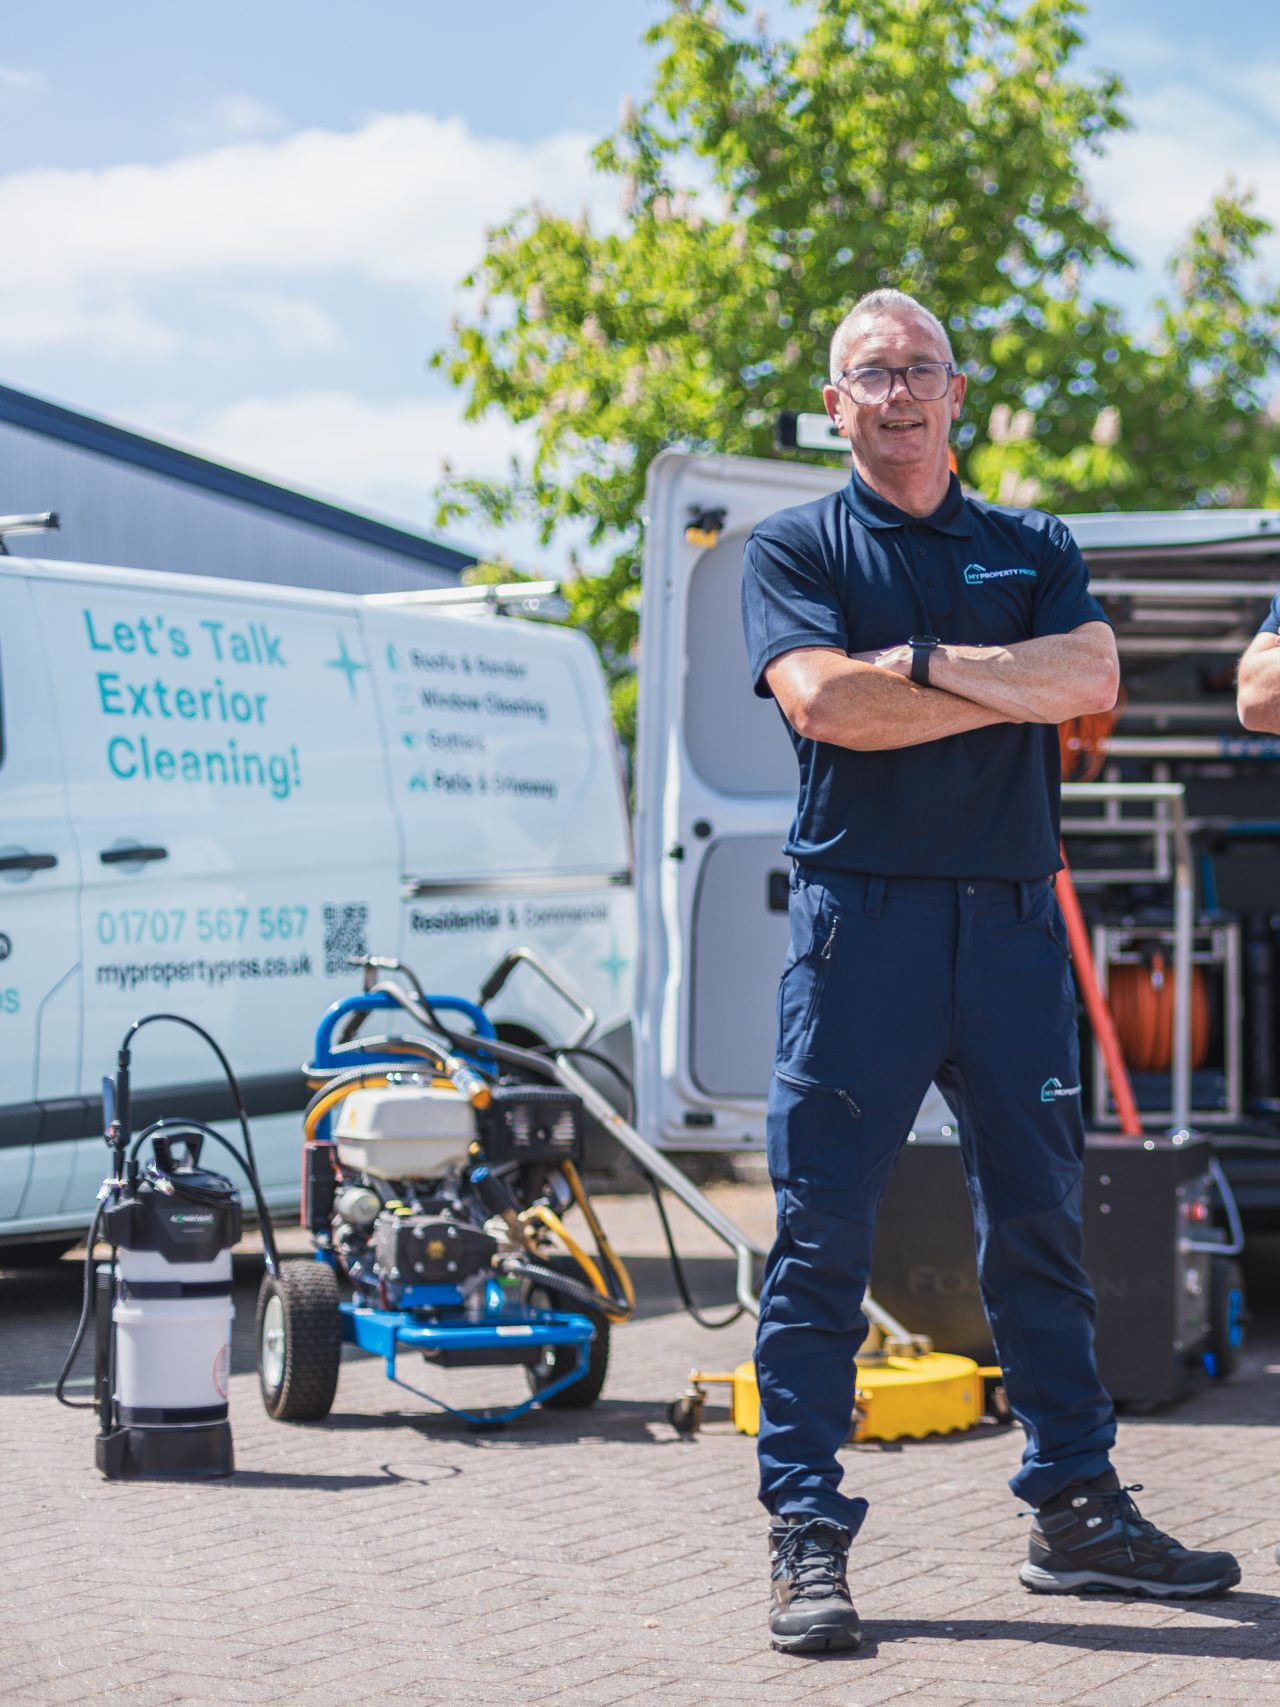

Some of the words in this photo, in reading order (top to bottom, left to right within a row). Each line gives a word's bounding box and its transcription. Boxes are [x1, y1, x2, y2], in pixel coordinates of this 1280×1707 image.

[83, 608, 190, 657] Let's
[199, 619, 287, 667] Talk
[97, 671, 267, 724] Exterior
[108, 734, 301, 799] Cleaning!
[97, 909, 187, 944] 01707
[197, 907, 249, 941] 567
[258, 905, 309, 940] 567
[97, 952, 312, 991] mypropertypros.co.uk
